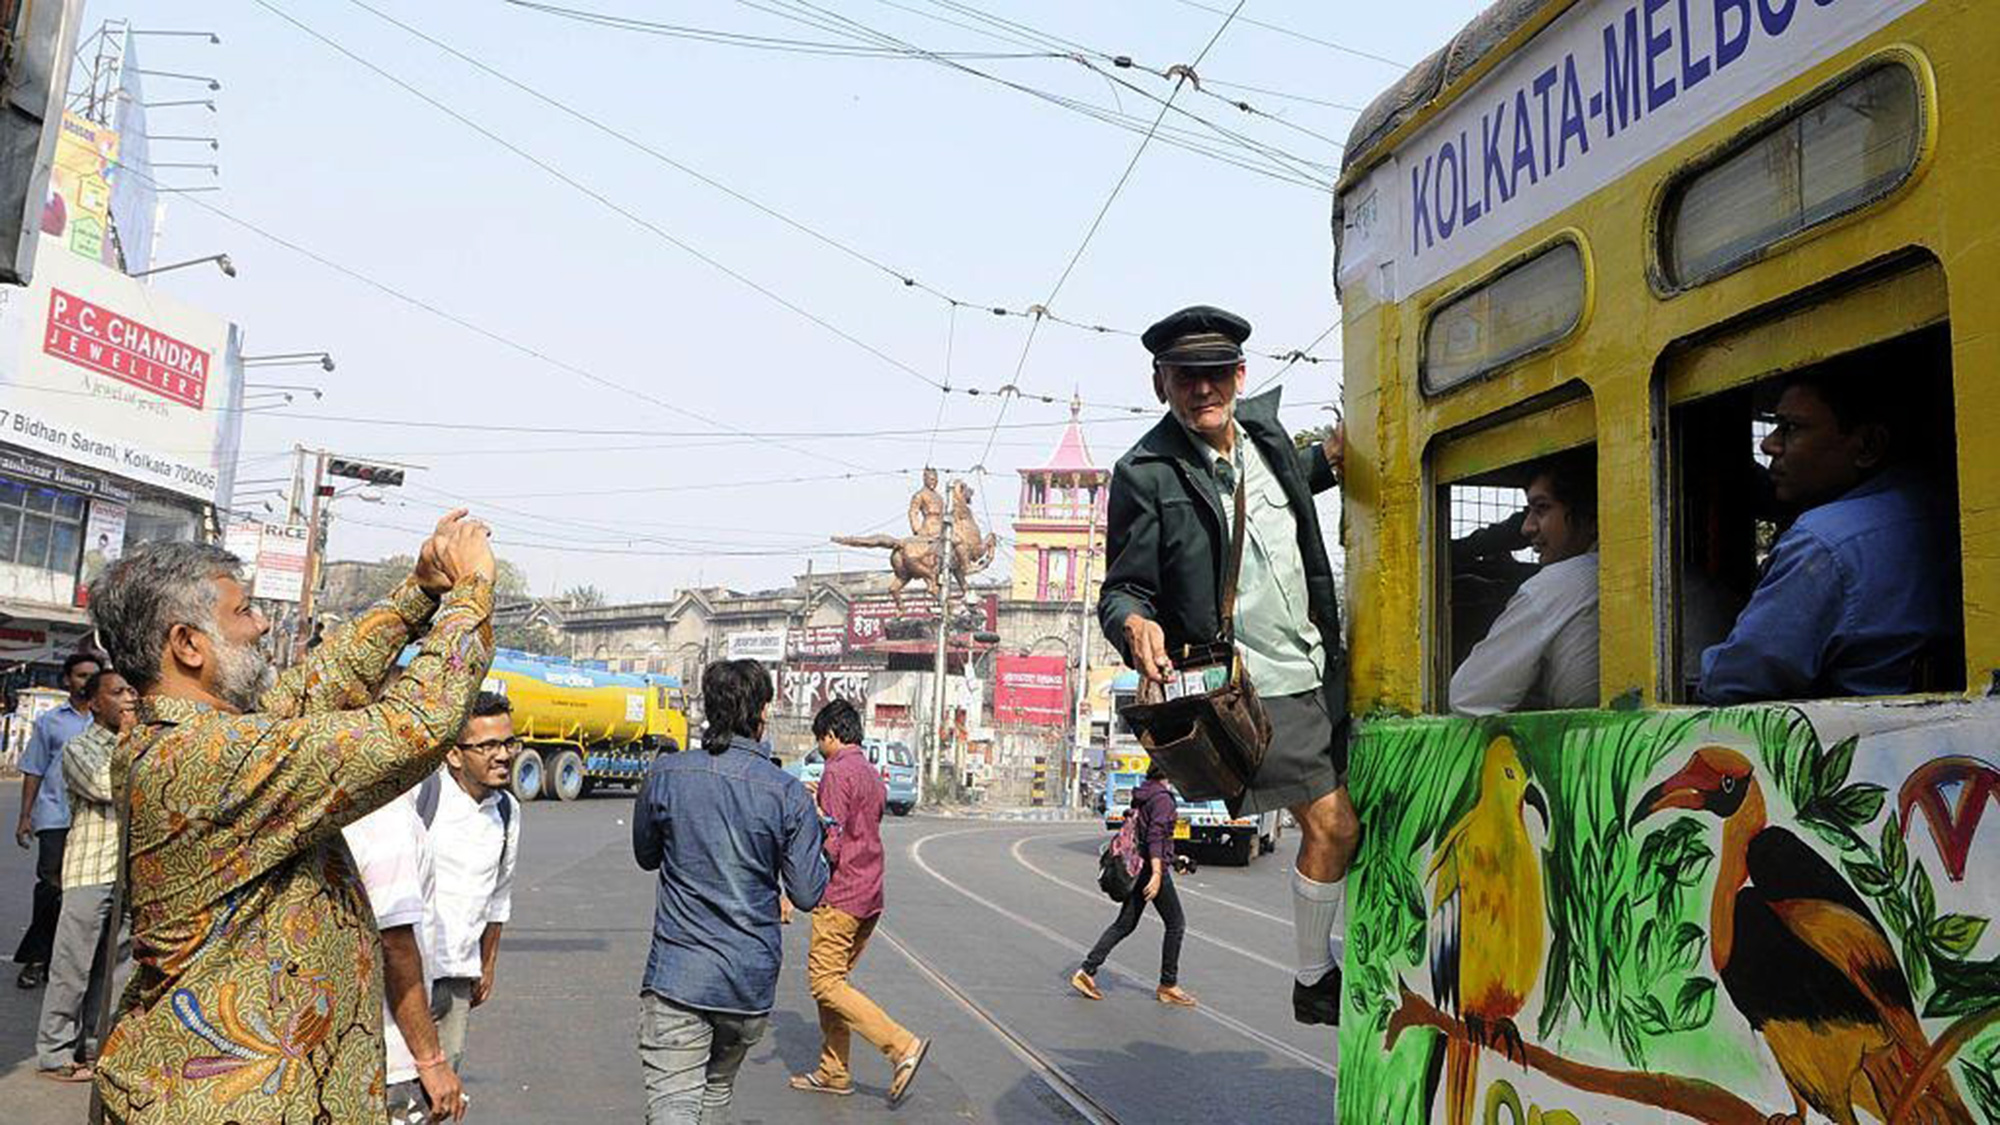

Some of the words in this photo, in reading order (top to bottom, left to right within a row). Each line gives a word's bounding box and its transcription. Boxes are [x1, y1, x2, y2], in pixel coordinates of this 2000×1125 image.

[50, 329, 204, 400] JEWELLERS
[107, 319, 204, 378] CHANDRA
[13, 414, 67, 446] Bidhan
[72, 432, 118, 462] Sarani,
[124, 449, 171, 476] Kolkata
